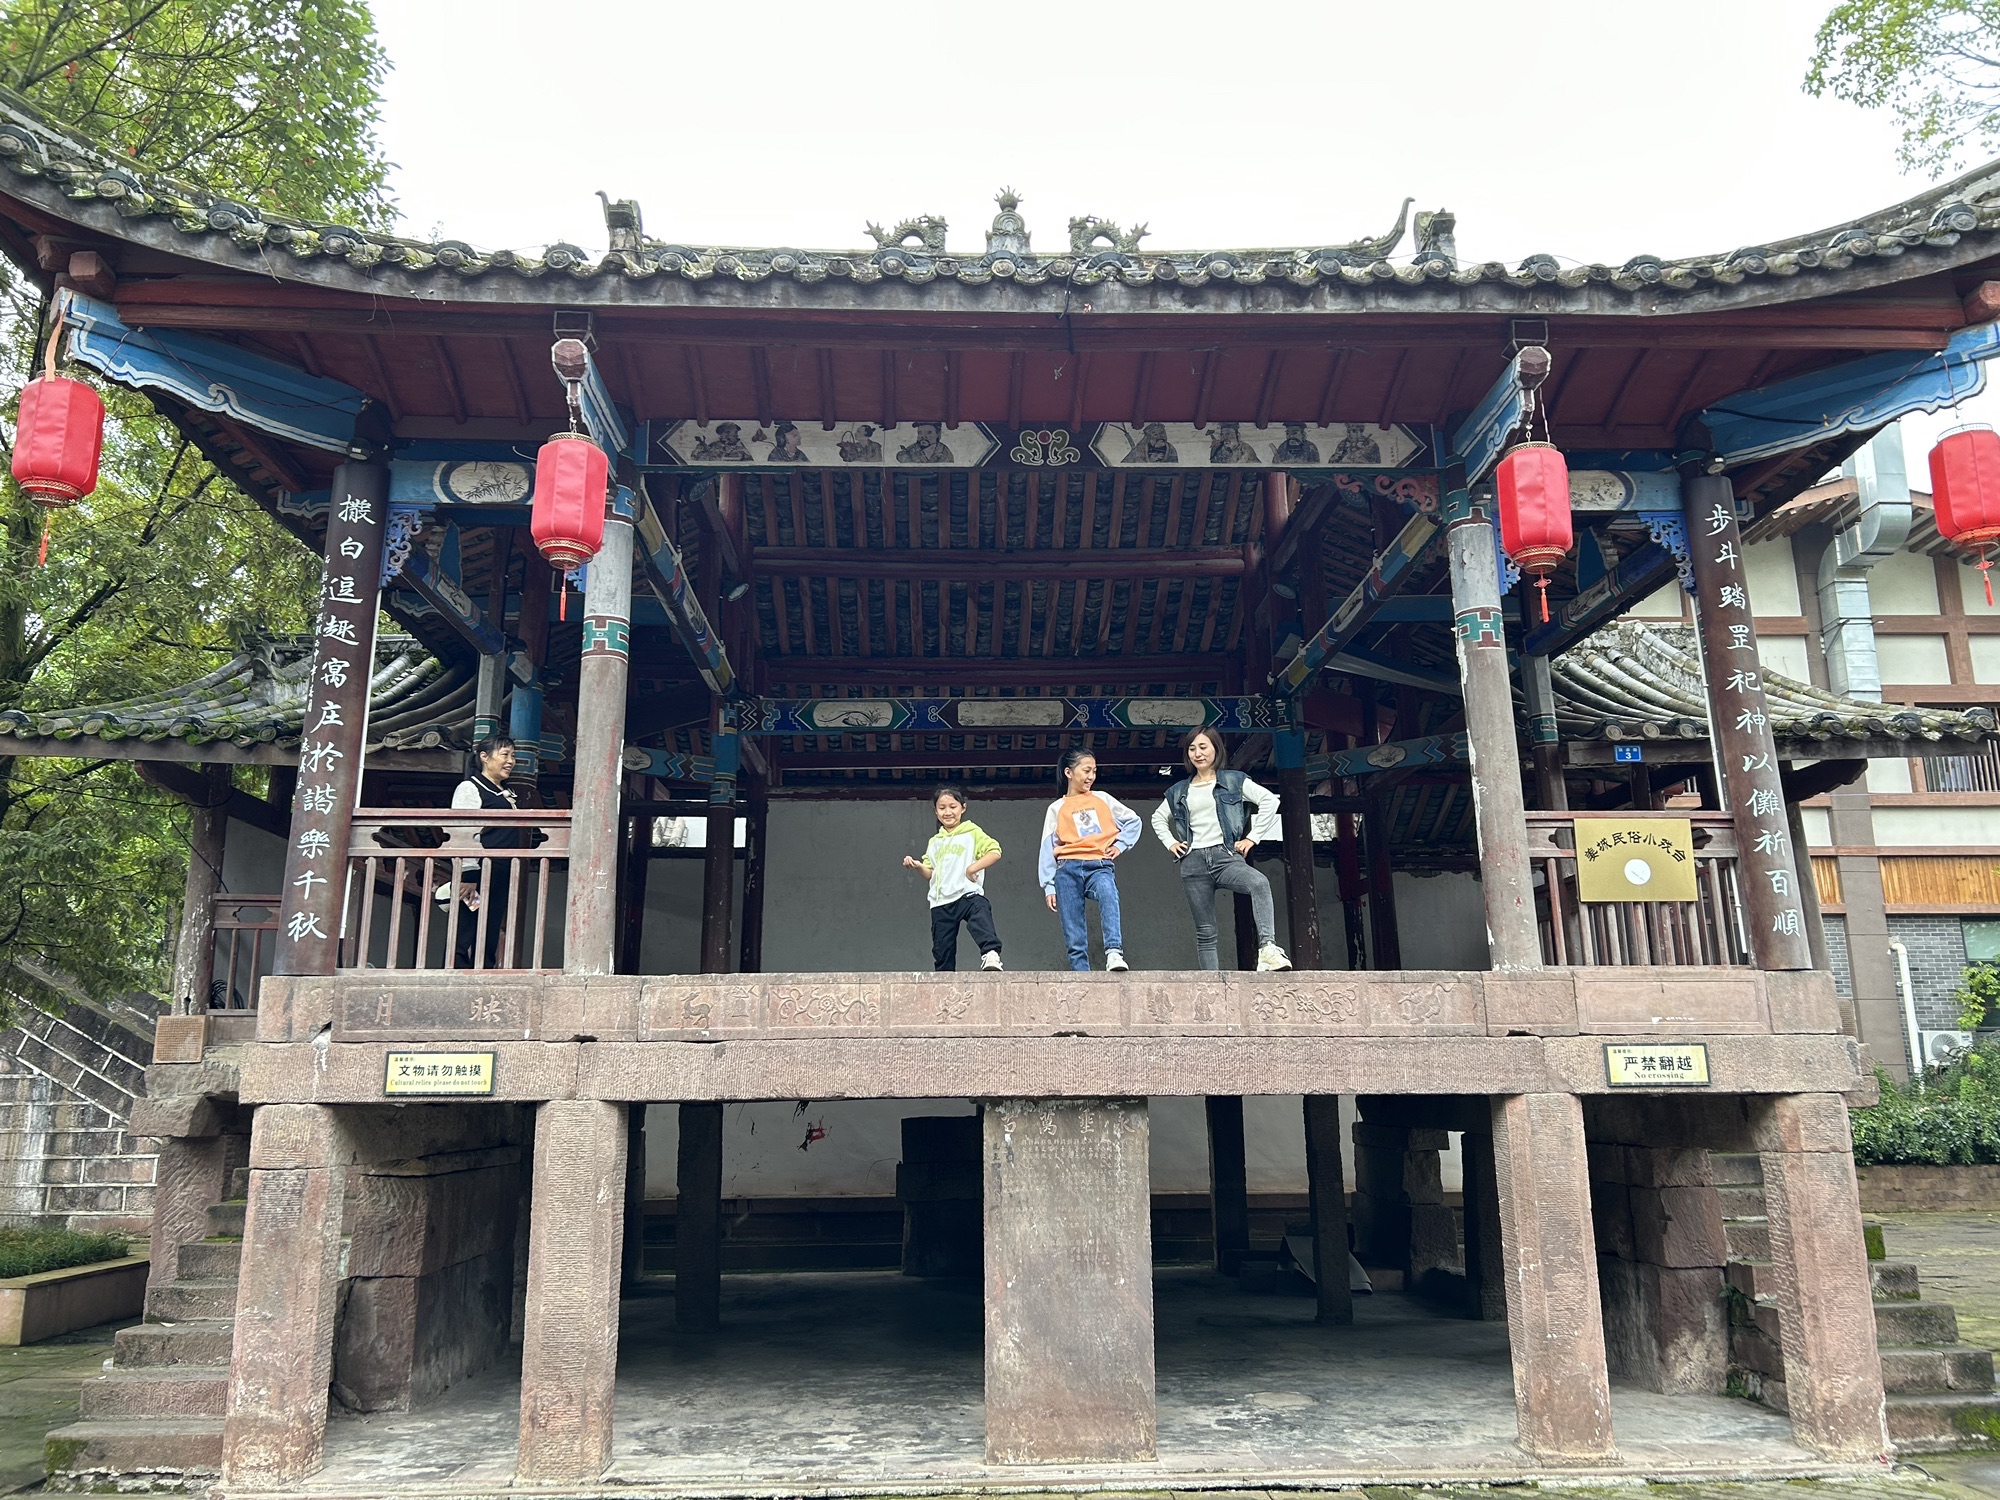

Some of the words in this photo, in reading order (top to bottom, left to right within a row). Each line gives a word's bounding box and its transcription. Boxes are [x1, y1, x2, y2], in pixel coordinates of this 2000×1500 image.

[1623, 1055, 1693, 1071] 严禁翻越
[398, 1064, 482, 1077] 文物请勿触摸
[1647, 1072, 1685, 1080] crossing
[433, 1079, 452, 1087] please
